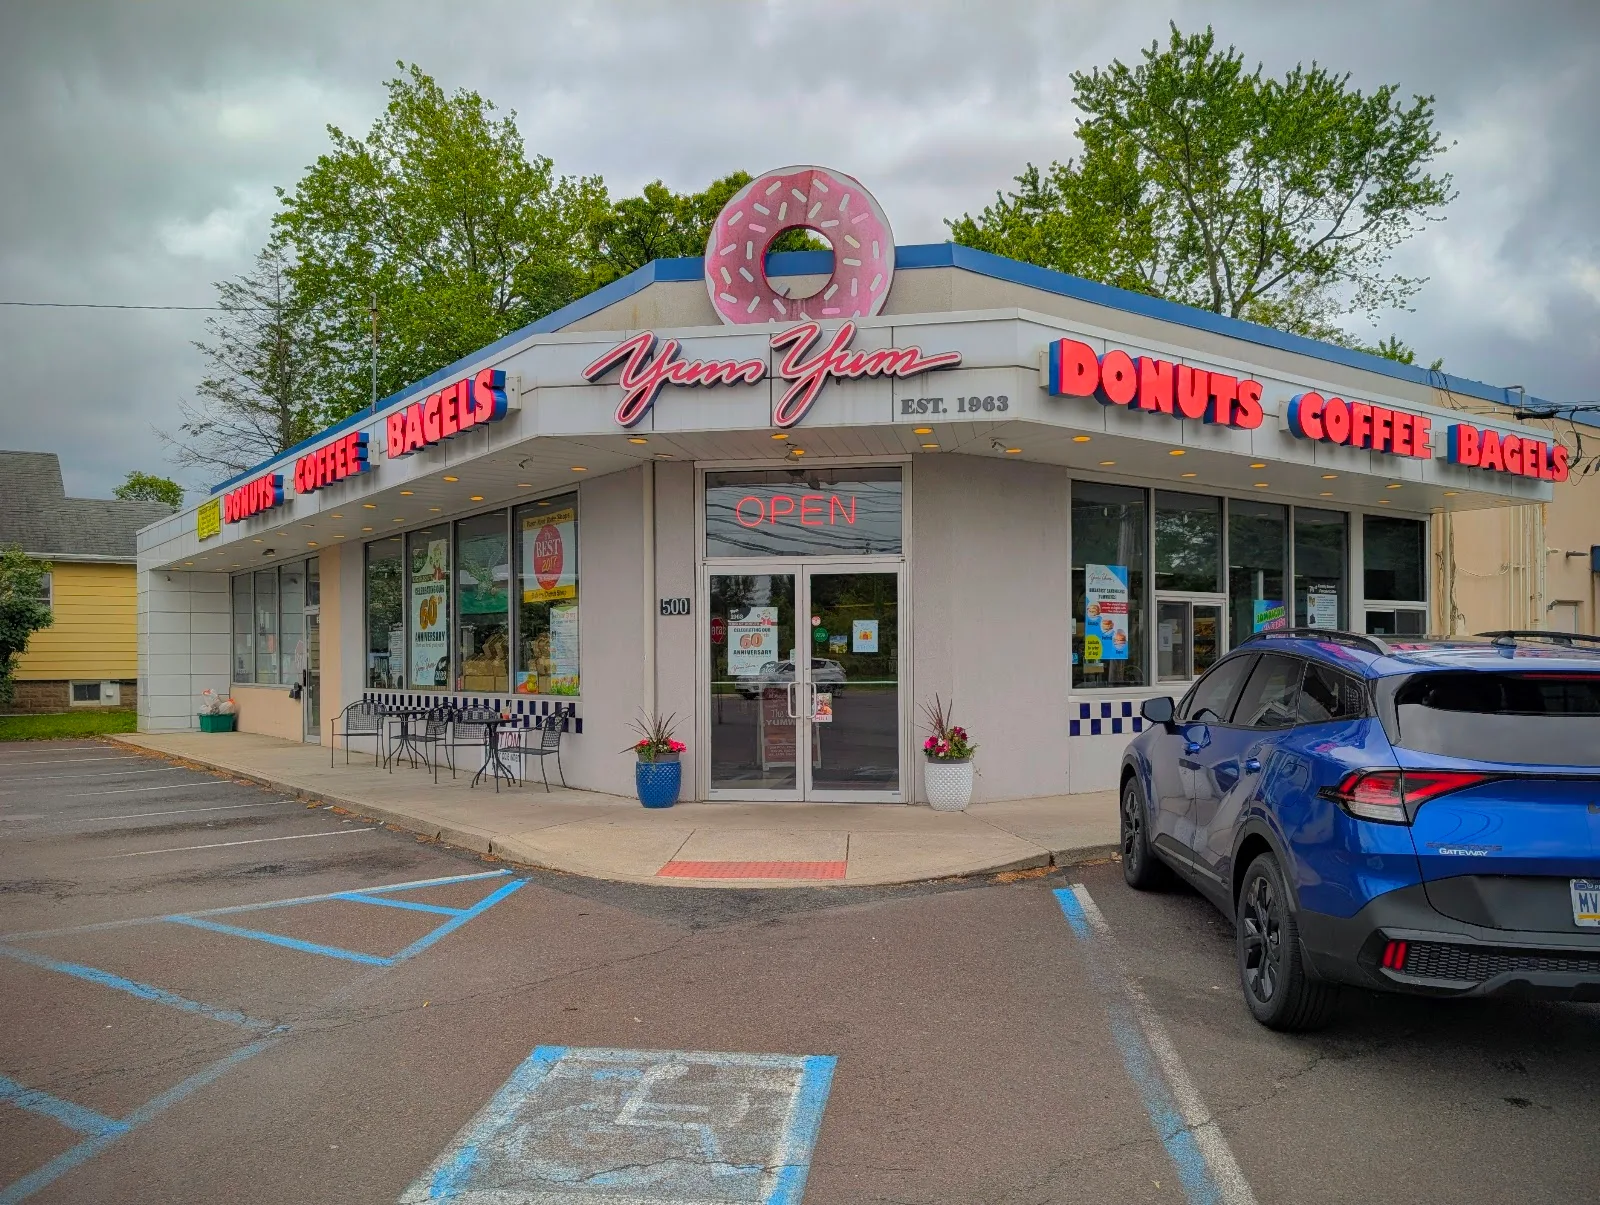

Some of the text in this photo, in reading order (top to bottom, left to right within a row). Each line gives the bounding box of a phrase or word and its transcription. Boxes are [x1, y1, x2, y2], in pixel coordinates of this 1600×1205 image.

[580, 320, 963, 429] Yum Yum
[1050, 338, 1264, 430] DONUTS
[387, 369, 505, 459] BAGELS
[901, 395, 1009, 415] EST. 1963
[1290, 391, 1433, 461] COFFEE
[294, 431, 369, 495] COFFEE
[1449, 423, 1570, 483] BAGELS
[224, 473, 281, 525] DONUTS
[736, 495, 857, 527] OPEN
[536, 539, 561, 557] BEST
[662, 599, 689, 615] 500
[415, 631, 445, 642] ANNIVERSARY
[1438, 847, 1488, 857] GATEWAY
